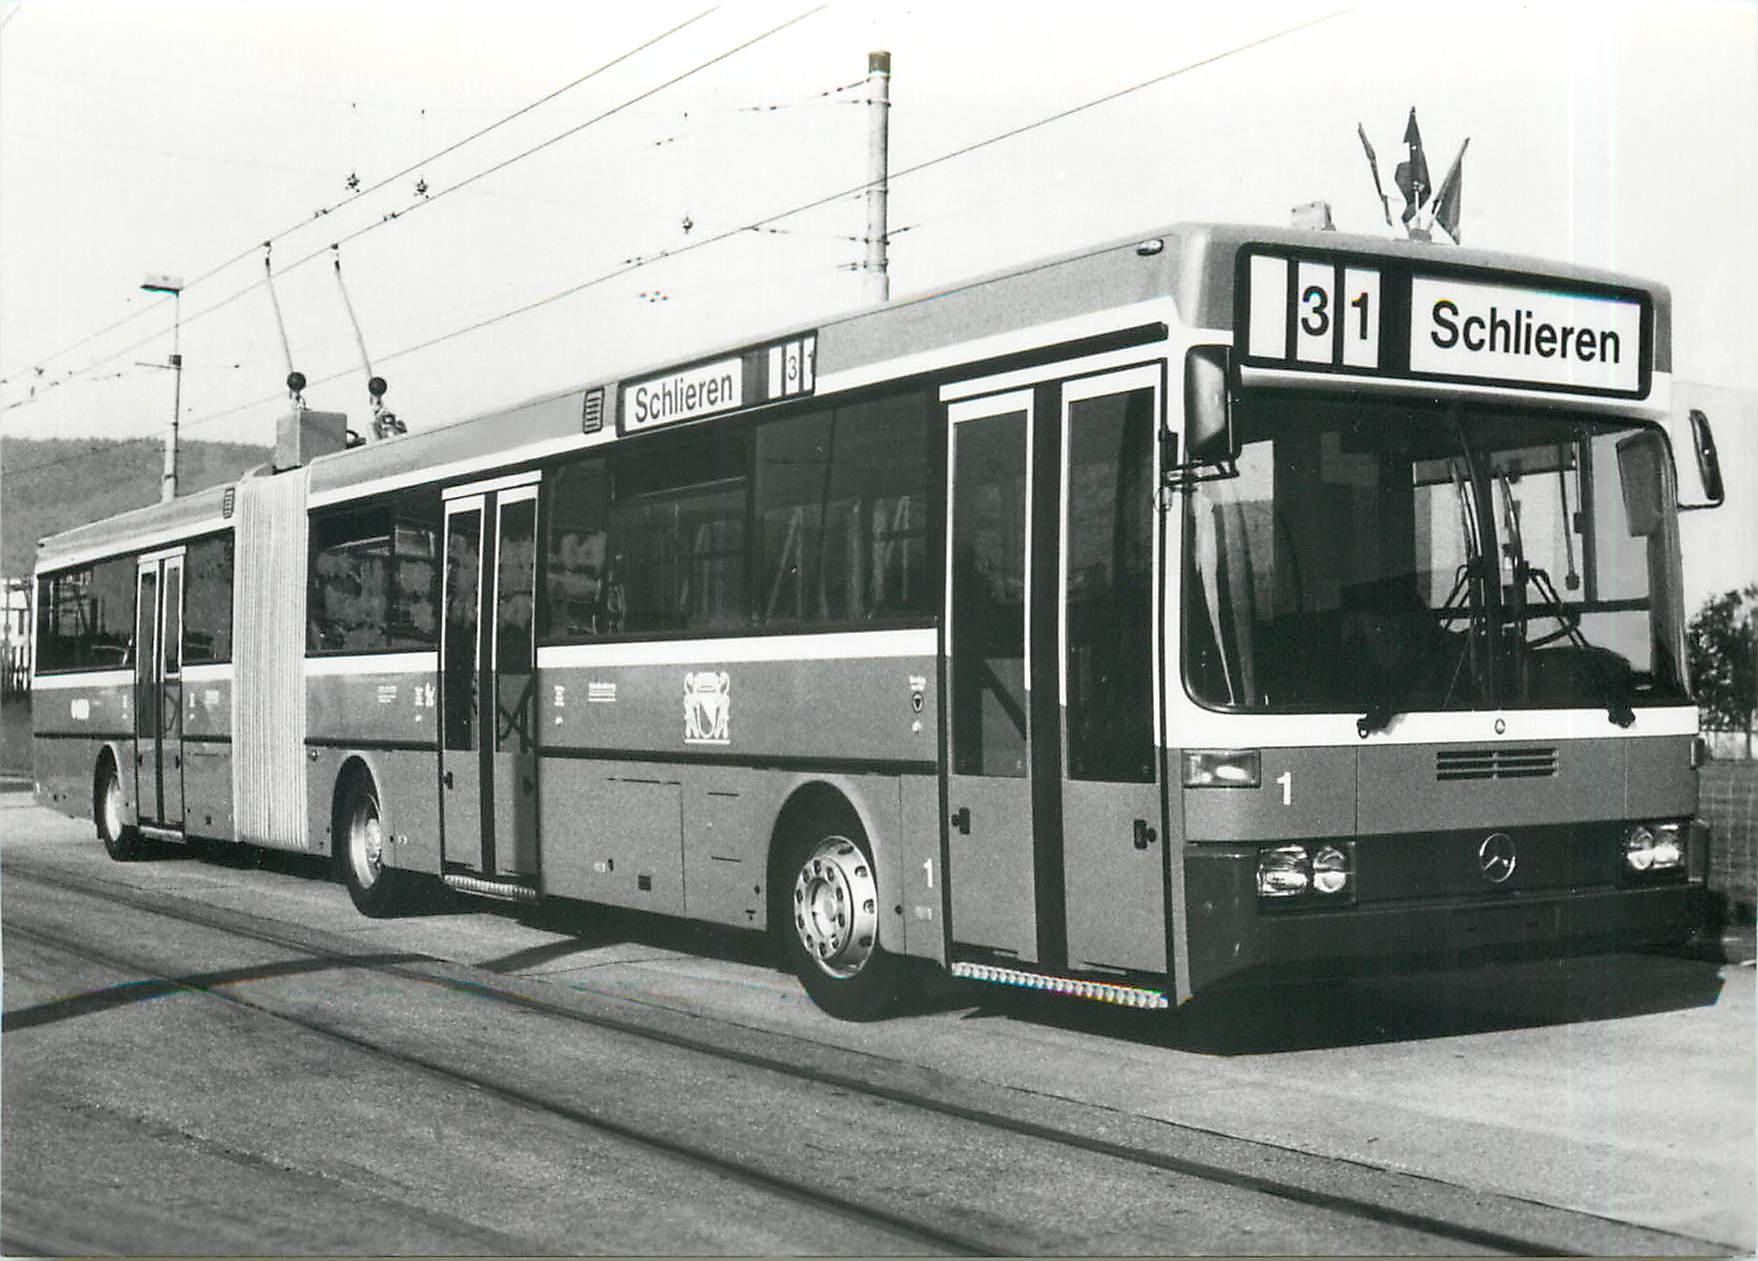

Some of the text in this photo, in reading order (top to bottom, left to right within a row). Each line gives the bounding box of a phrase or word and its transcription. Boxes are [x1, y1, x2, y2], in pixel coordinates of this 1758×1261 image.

[1431, 299, 1621, 364] Schlieren
[635, 373, 733, 423] Schlieren
[1276, 771, 1291, 805] 1
[923, 858, 933, 888] 1
